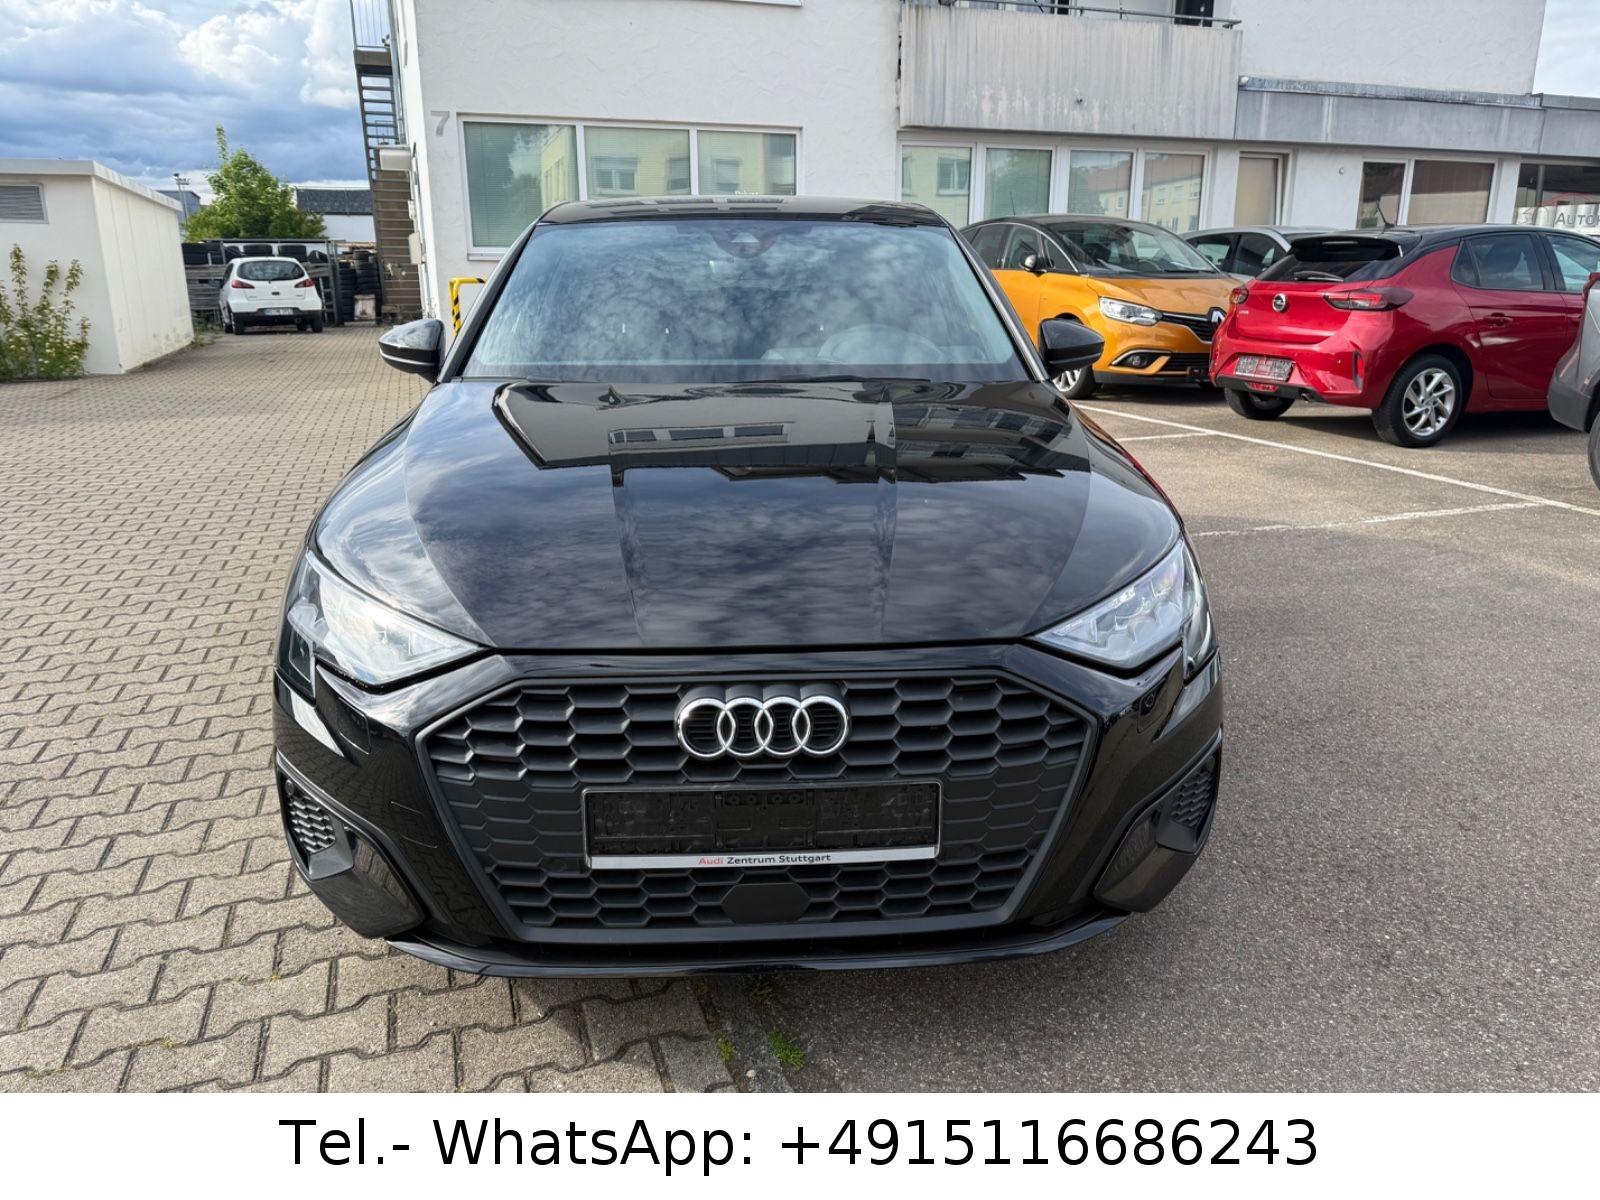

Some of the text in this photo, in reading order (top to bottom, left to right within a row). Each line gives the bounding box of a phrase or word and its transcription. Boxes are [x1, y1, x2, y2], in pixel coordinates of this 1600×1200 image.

[430, 110, 450, 137] 7
[698, 853, 831, 865] Audi Zentrum Stuttgart
